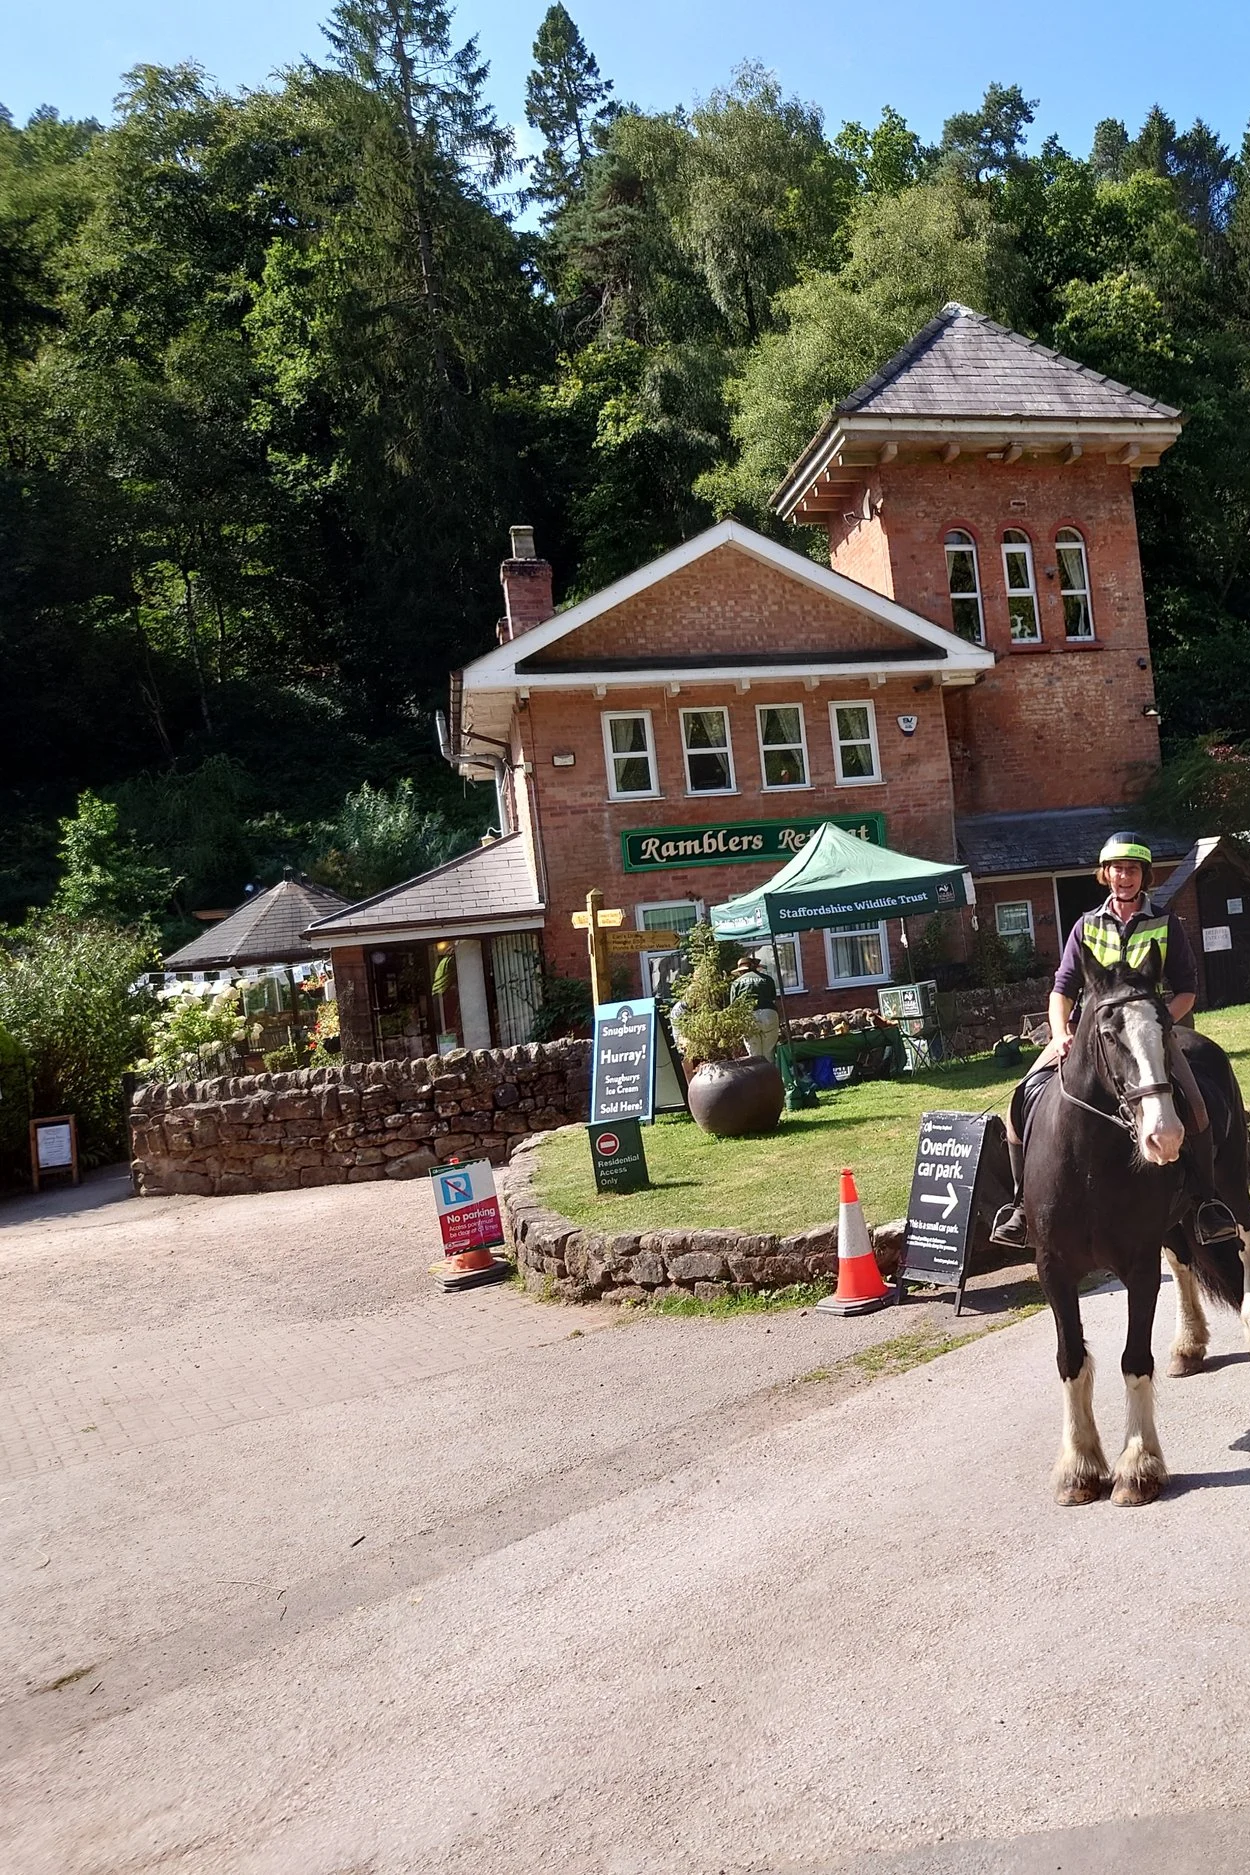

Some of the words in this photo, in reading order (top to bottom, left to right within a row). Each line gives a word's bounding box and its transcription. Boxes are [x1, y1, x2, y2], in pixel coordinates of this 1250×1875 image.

[640, 830, 763, 862] Ramblers
[777, 824, 870, 853] Retat
[779, 904, 853, 919] Staffordshire
[854, 897, 898, 911] Wildlife
[898, 891, 928, 905] Trust
[602, 1023, 647, 1037] Snugburys
[600, 1044, 647, 1066] Hurray!
[604, 1074, 640, 1085] Snugburys
[605, 1086, 616, 1096] Ice
[616, 1084, 639, 1094] Cream
[600, 1102, 619, 1114] Sold
[620, 1099, 643, 1112] Here!
[921, 1137, 973, 1158] Overflow
[597, 1153, 640, 1168] Residential
[600, 1166, 627, 1177] Access
[917, 1162, 936, 1177] car
[934, 1160, 964, 1182] park.
[600, 1177, 619, 1186] Only
[446, 1215, 461, 1224] No
[462, 1208, 496, 1223] parking
